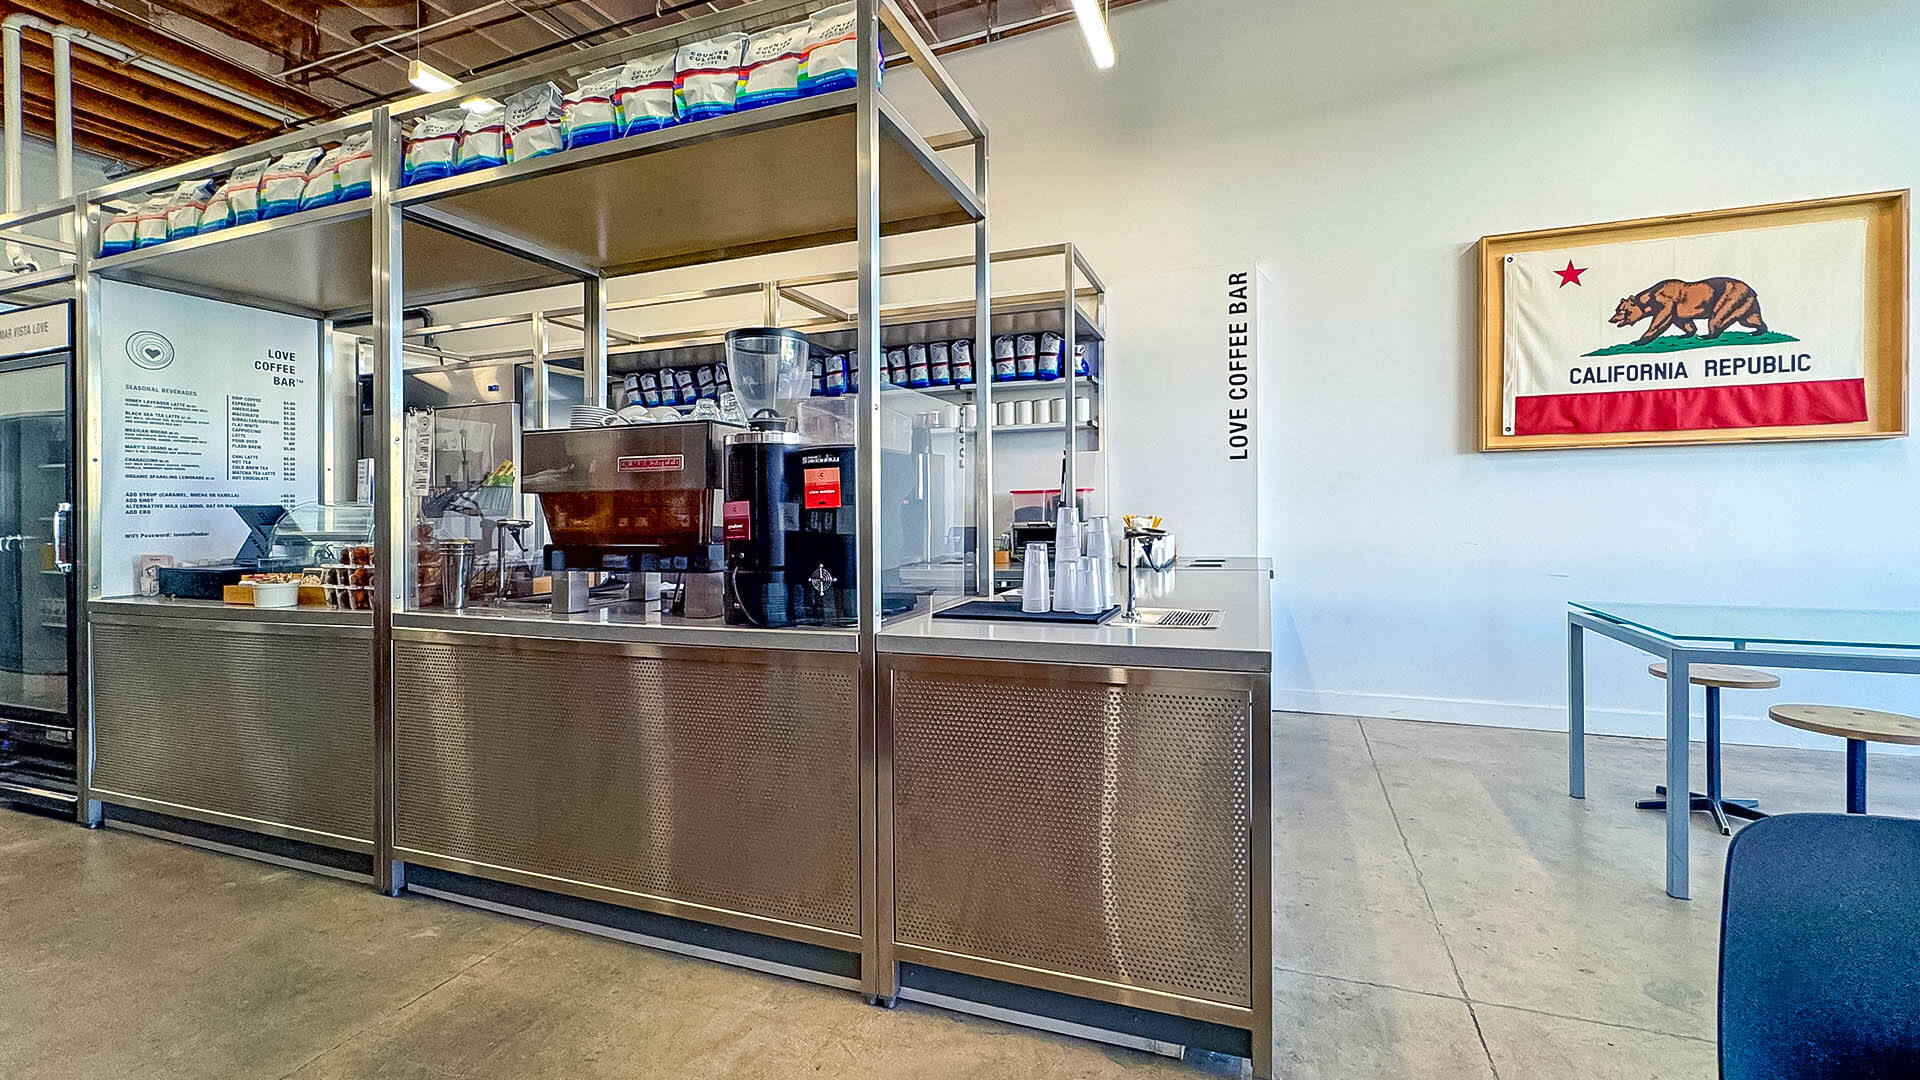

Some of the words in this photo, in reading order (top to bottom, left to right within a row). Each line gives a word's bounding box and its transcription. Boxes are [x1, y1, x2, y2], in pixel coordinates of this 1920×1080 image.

[1229, 272, 1248, 314] BAR
[33, 322, 48, 334] LOVE
[268, 349, 295, 361] LOVE
[1229, 322, 1248, 400] COFFEE
[255, 360, 295, 374] COFFEE
[1570, 362, 1688, 384] CALIFORNIA
[1705, 354, 1812, 377] REPUBLIC
[125, 384, 159, 392] SEASONAL
[162, 388, 197, 396] BEVERAGES
[1229, 408, 1248, 460] LOVE
